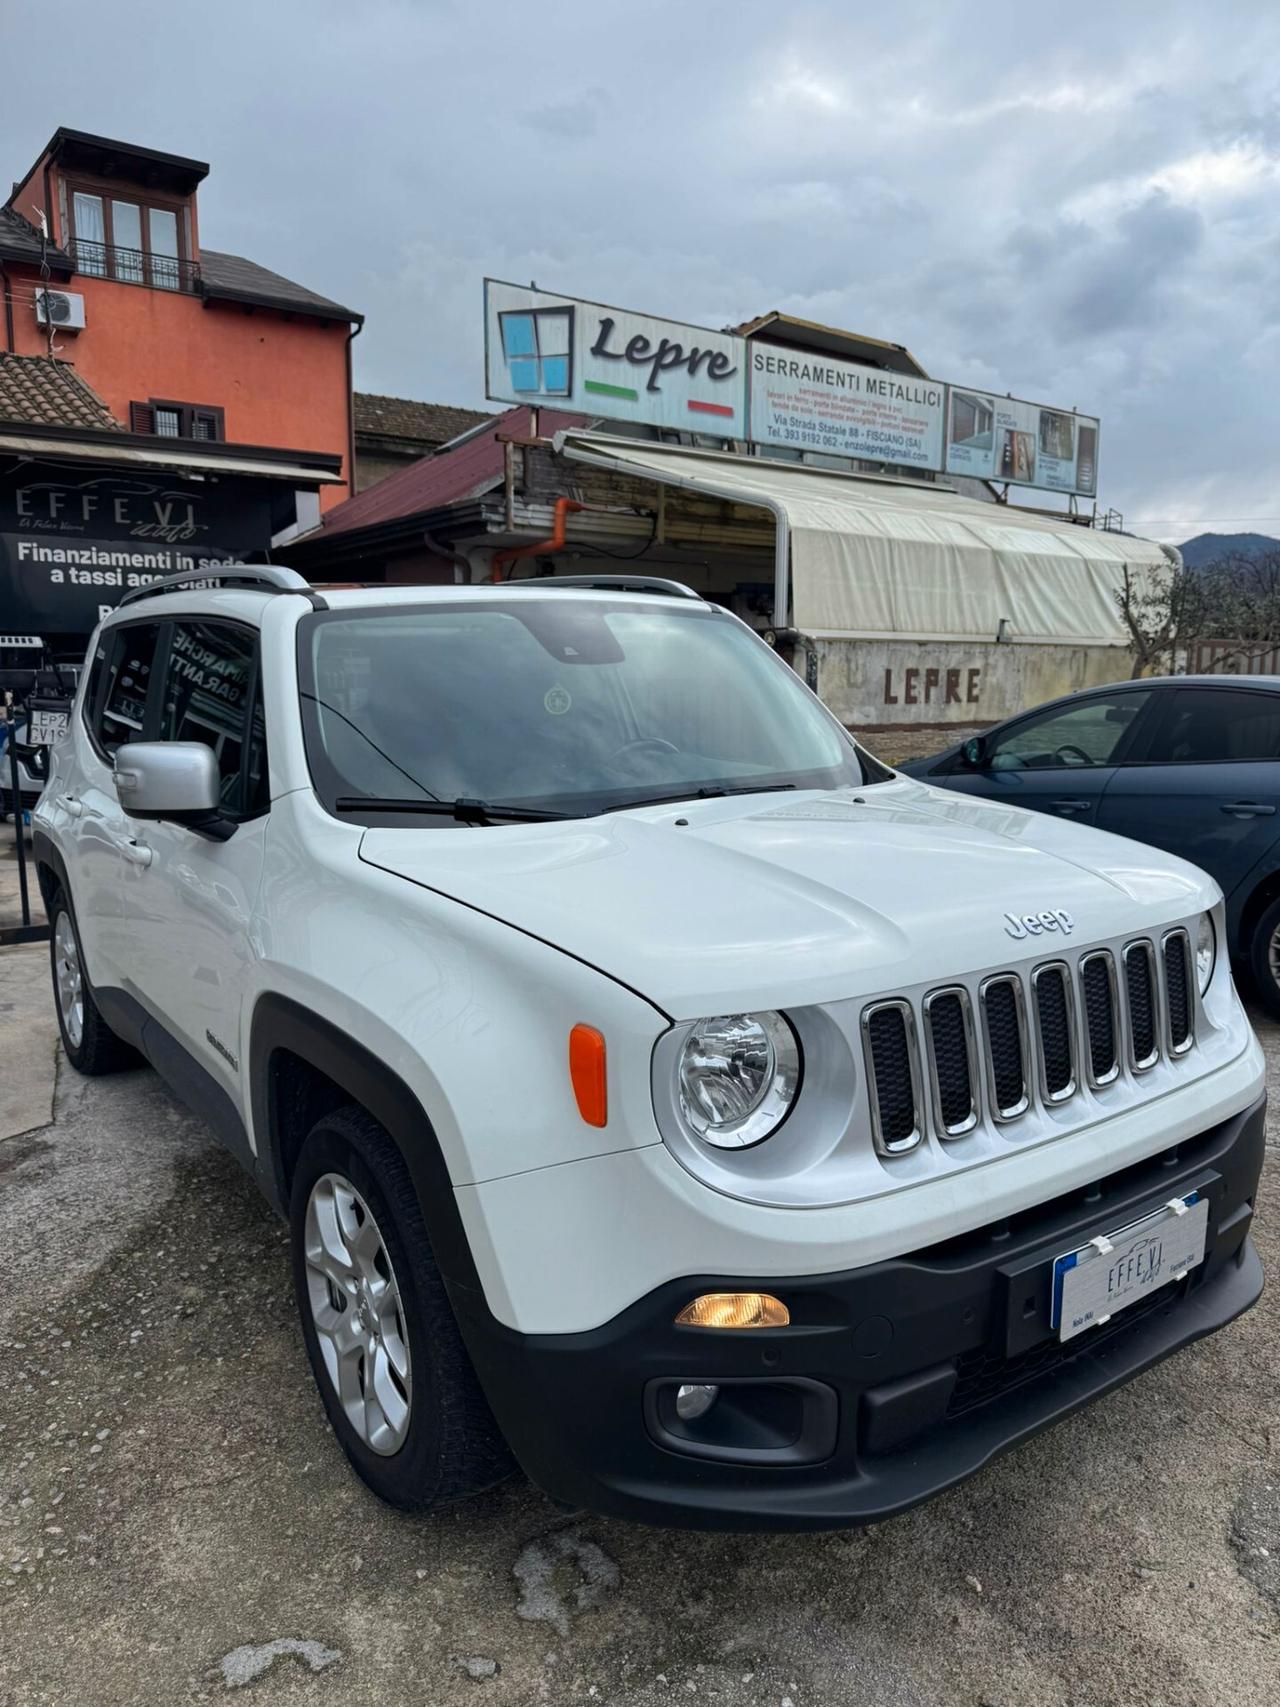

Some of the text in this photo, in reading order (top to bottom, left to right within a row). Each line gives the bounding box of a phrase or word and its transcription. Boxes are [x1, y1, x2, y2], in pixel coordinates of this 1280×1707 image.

[590, 318, 737, 392] Lepre
[754, 353, 940, 407] SERRAMENTI METALLICI
[767, 426, 781, 437] Tel.
[784, 429, 799, 440] 393
[844, 438, 928, 463] enzolepre@gmail.com
[774, 414, 787, 425] Via
[790, 417, 815, 430] Strada
[819, 422, 845, 435] Statale
[848, 427, 858, 437] 88
[866, 430, 904, 445] FISCIANO
[17, 542, 171, 569] Finanziamenti
[176, 552, 195, 569] in
[51, 569, 64, 582] a
[70, 567, 123, 586] tassi
[884, 668, 981, 704] LEPRE
[1003, 908, 1074, 940] Jeep
